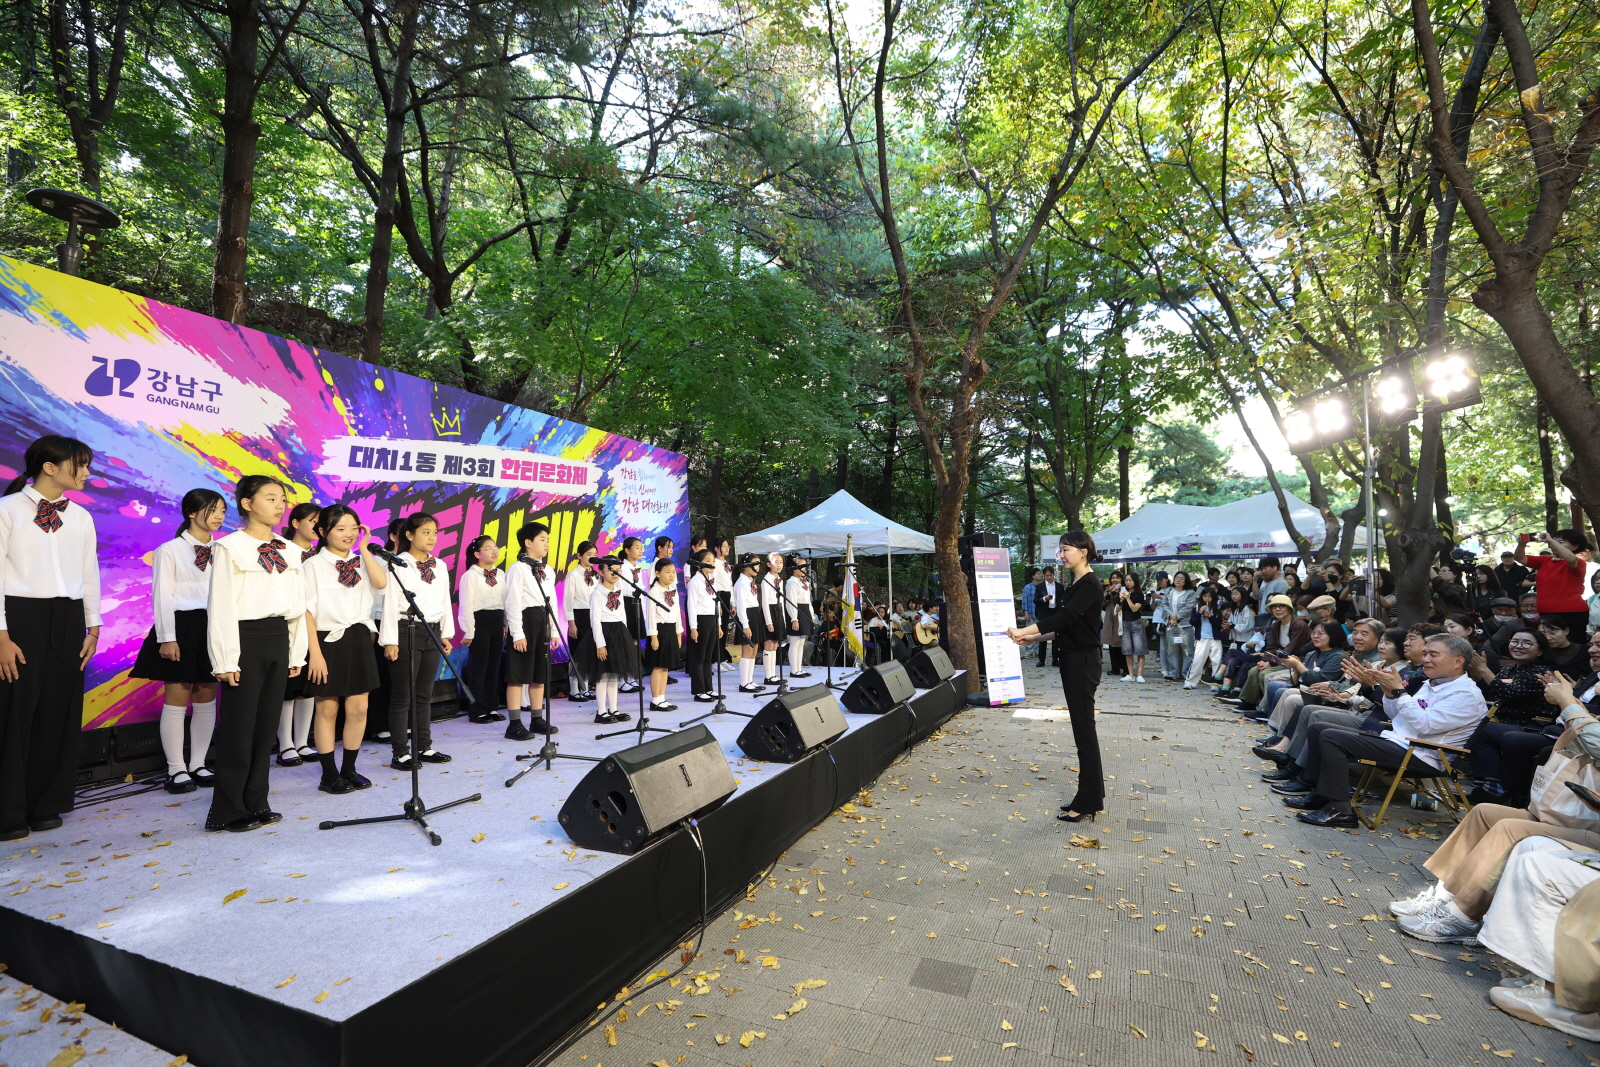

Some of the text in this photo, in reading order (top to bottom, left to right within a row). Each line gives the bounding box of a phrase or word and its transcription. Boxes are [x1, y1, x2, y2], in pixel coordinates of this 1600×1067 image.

[147, 368, 223, 402] 강남구
[146, 393, 220, 415] GANG NAM GU
[348, 445, 588, 486] 대치1동 제3회 한티문화제
[620, 467, 637, 481] 강남을
[621, 482, 638, 495] 구민을
[622, 496, 639, 514] 강남
